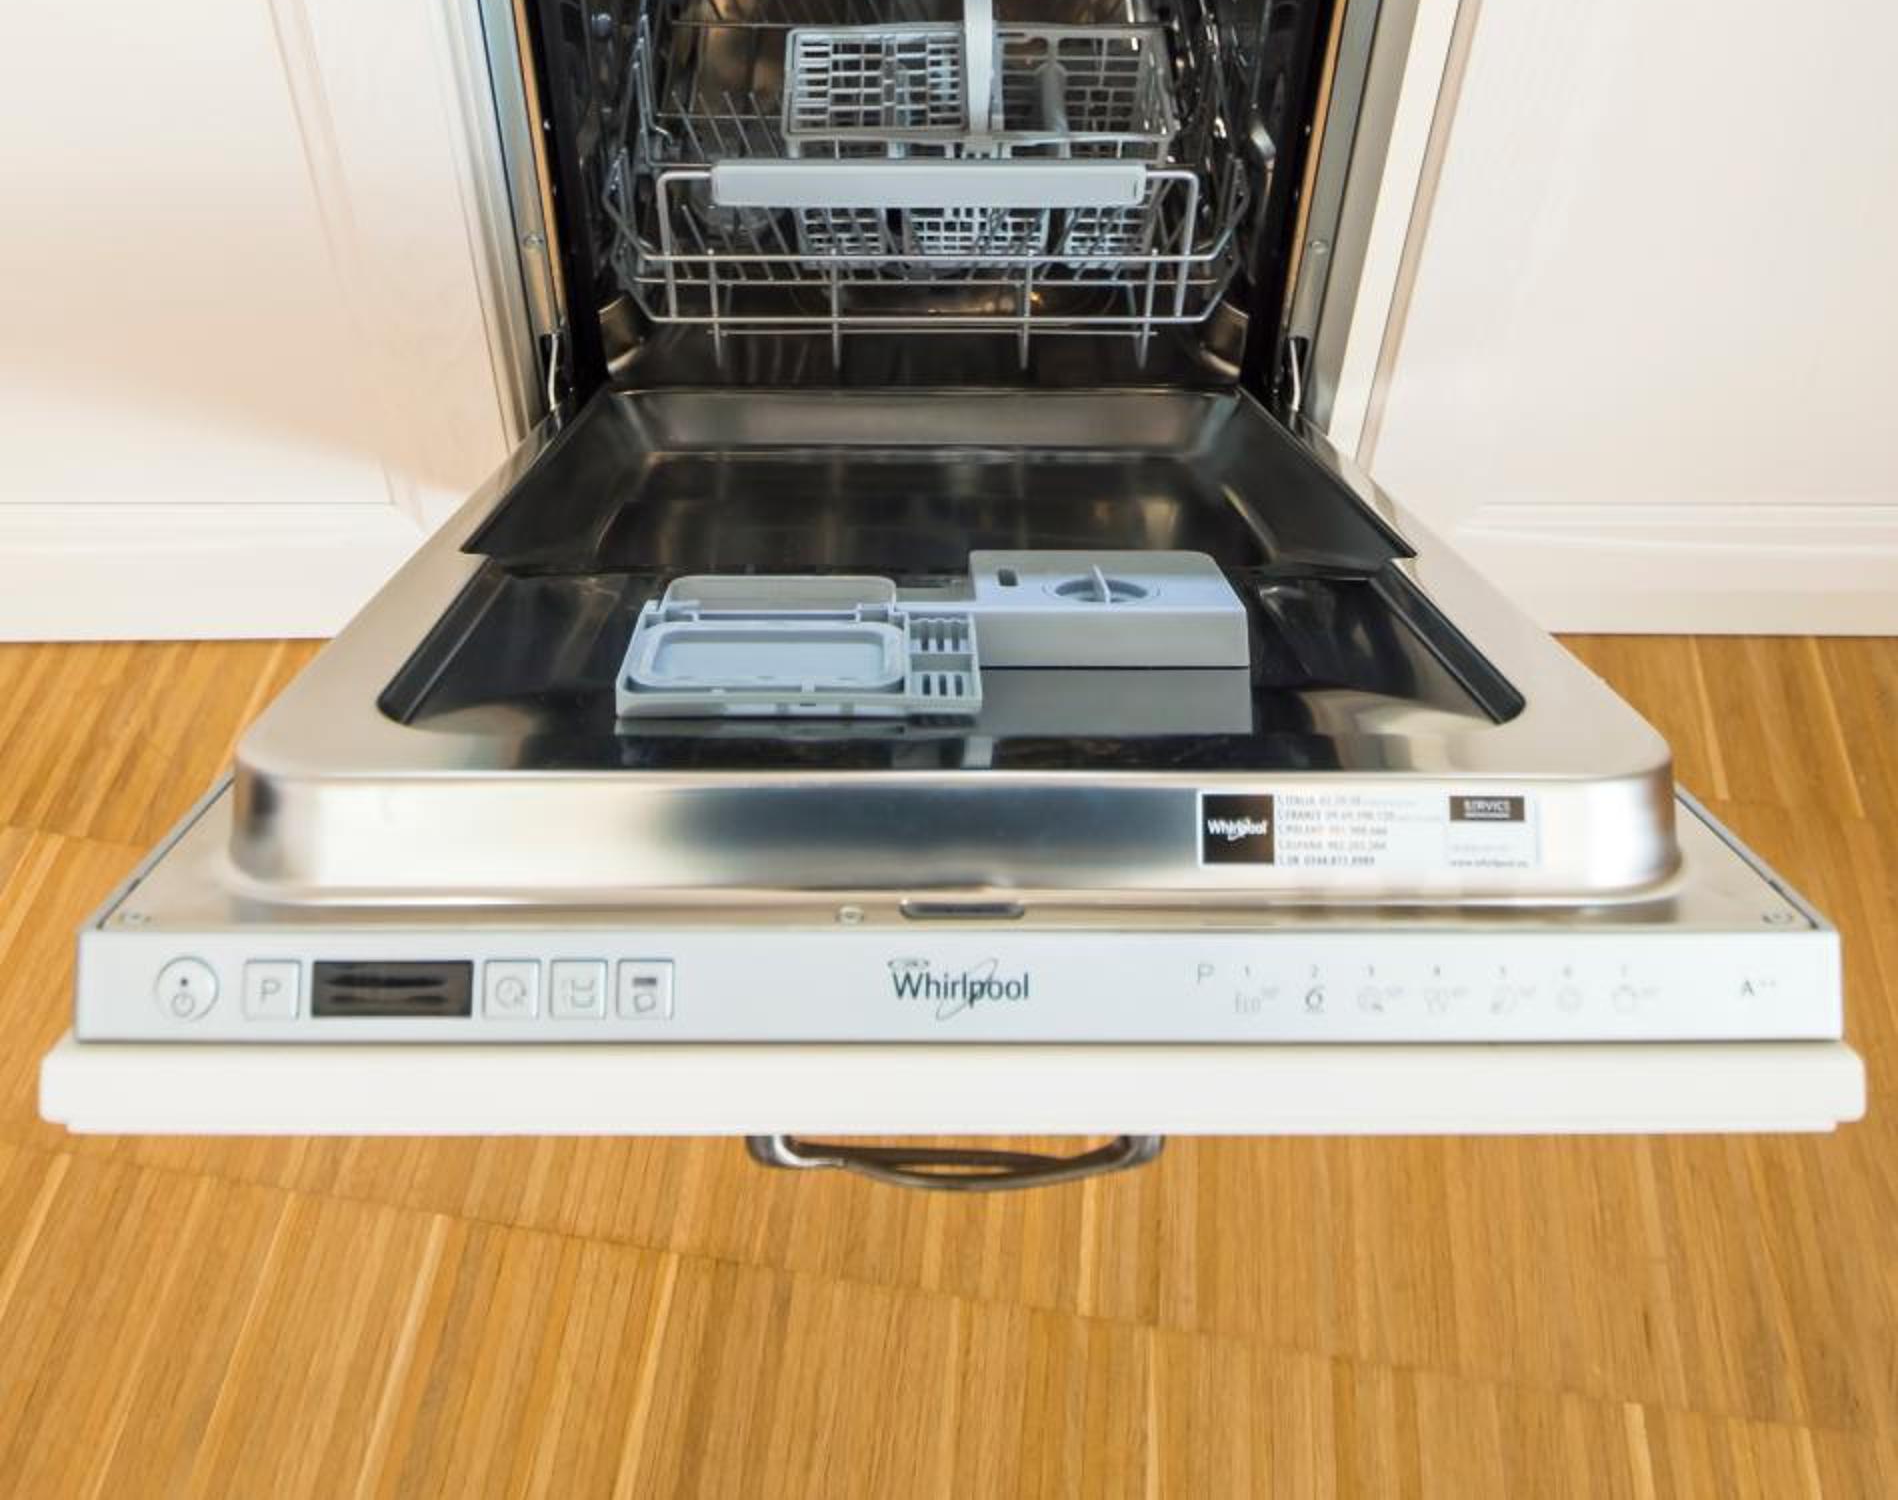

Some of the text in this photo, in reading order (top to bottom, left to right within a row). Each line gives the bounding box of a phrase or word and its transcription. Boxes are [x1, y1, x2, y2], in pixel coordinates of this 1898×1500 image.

[1197, 963, 1214, 984] P
[262, 978, 282, 1003] P
[892, 971, 1029, 1009] Whirlpool
